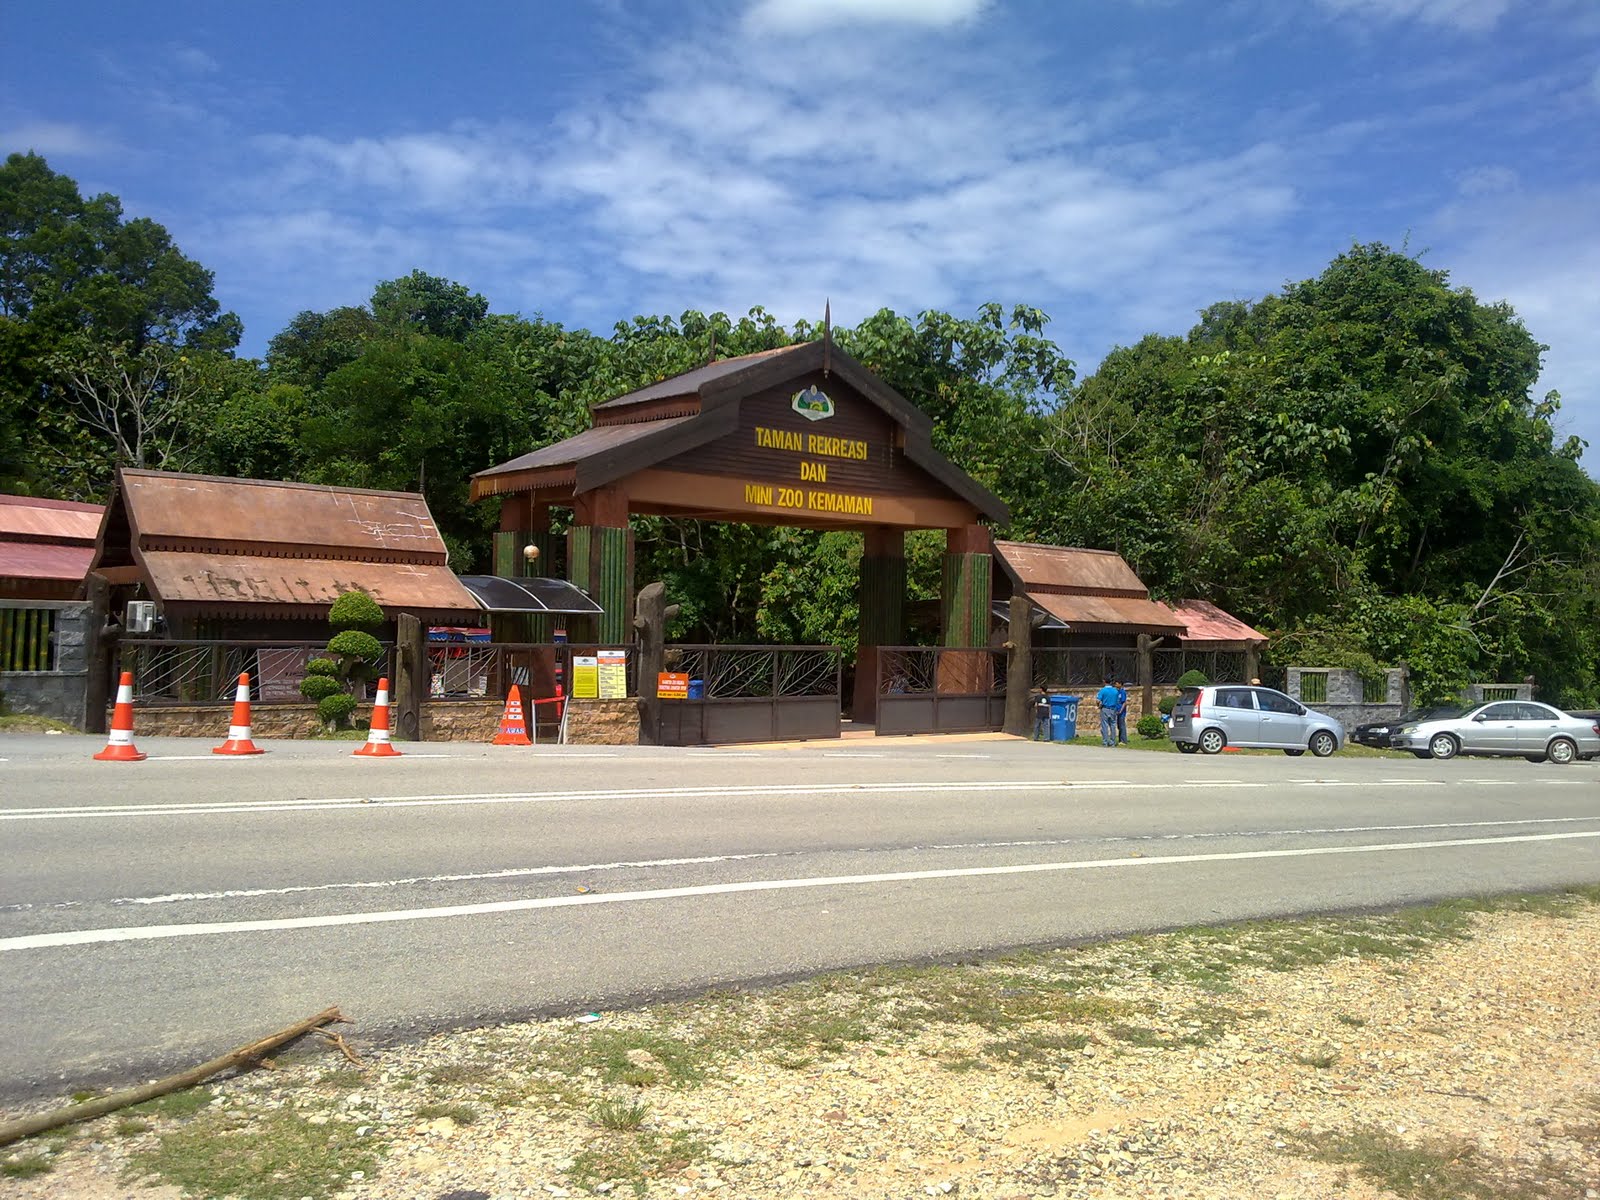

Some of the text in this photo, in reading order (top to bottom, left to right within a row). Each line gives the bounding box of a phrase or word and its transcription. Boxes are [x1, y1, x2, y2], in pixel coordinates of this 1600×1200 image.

[755, 427, 868, 460] TAMAN REKREASI
[801, 462, 827, 482] DAN
[745, 484, 872, 515] MINI ZOO KEMAMAN
[1064, 704, 1076, 722] 18
